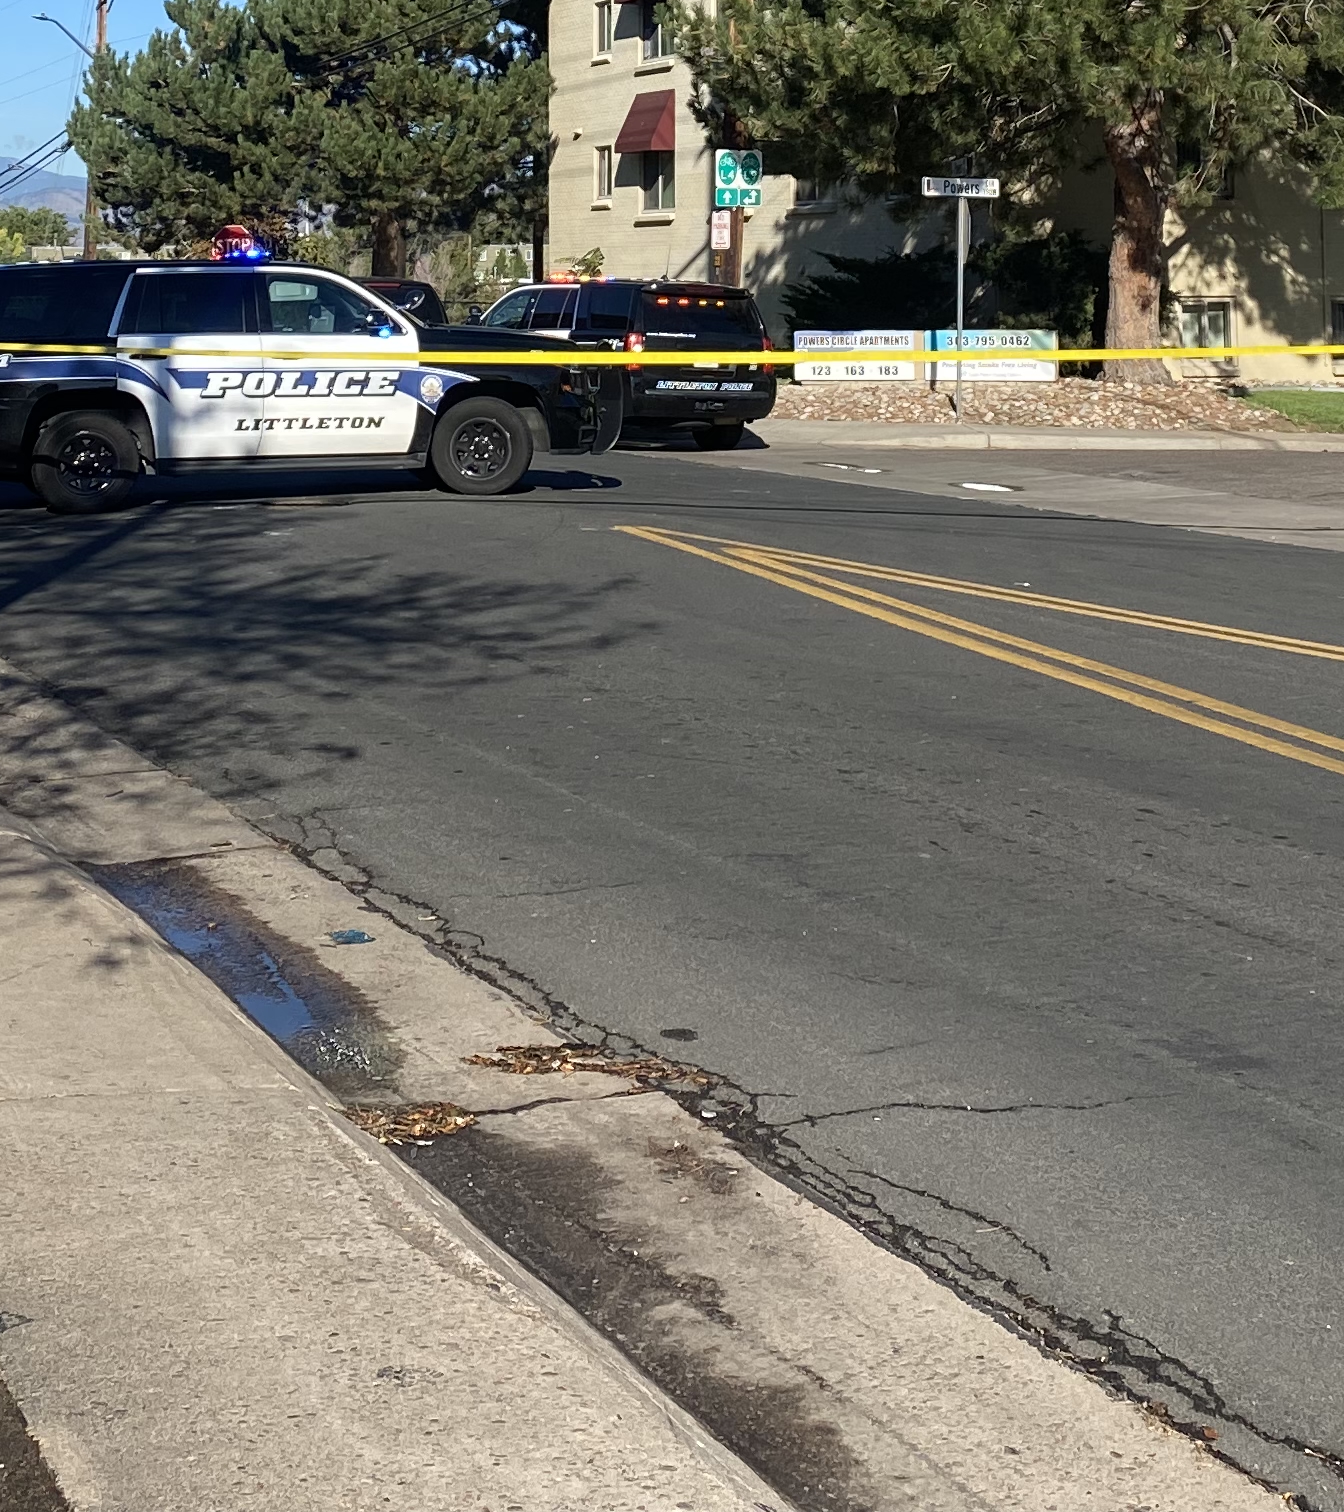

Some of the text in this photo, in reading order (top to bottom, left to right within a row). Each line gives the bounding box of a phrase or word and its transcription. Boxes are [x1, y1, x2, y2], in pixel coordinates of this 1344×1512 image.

[943, 180, 980, 194] Powers
[216, 238, 251, 253] STOP
[798, 335, 910, 346] POWERS CIRCLE APARTMENTS
[811, 366, 899, 376] 123 163 183
[200, 371, 401, 398] POLICE
[656, 380, 754, 392] LITTLETON POLICE
[234, 416, 386, 432] LITTLETON
